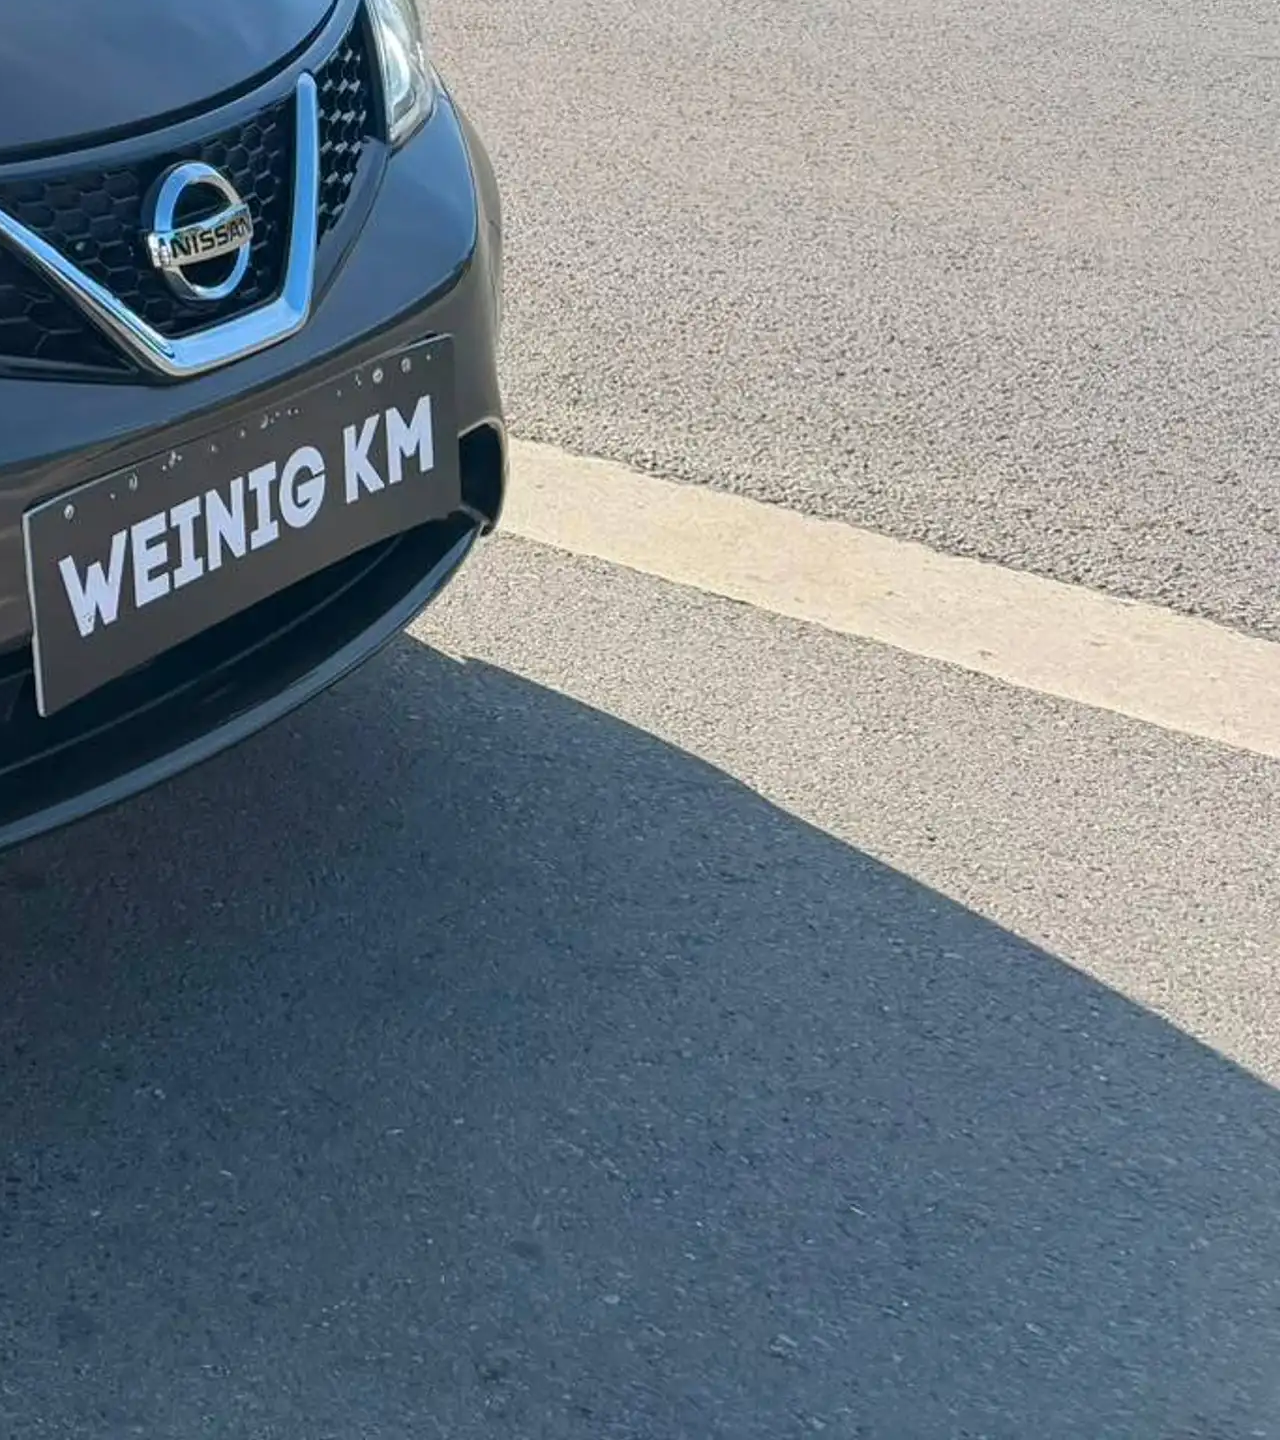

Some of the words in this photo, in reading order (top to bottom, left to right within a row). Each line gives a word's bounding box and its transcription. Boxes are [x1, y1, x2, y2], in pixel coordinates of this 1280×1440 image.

[170, 217, 247, 259] NISSAN
[58, 445, 325, 637] WEINIG
[343, 394, 434, 504] KM
